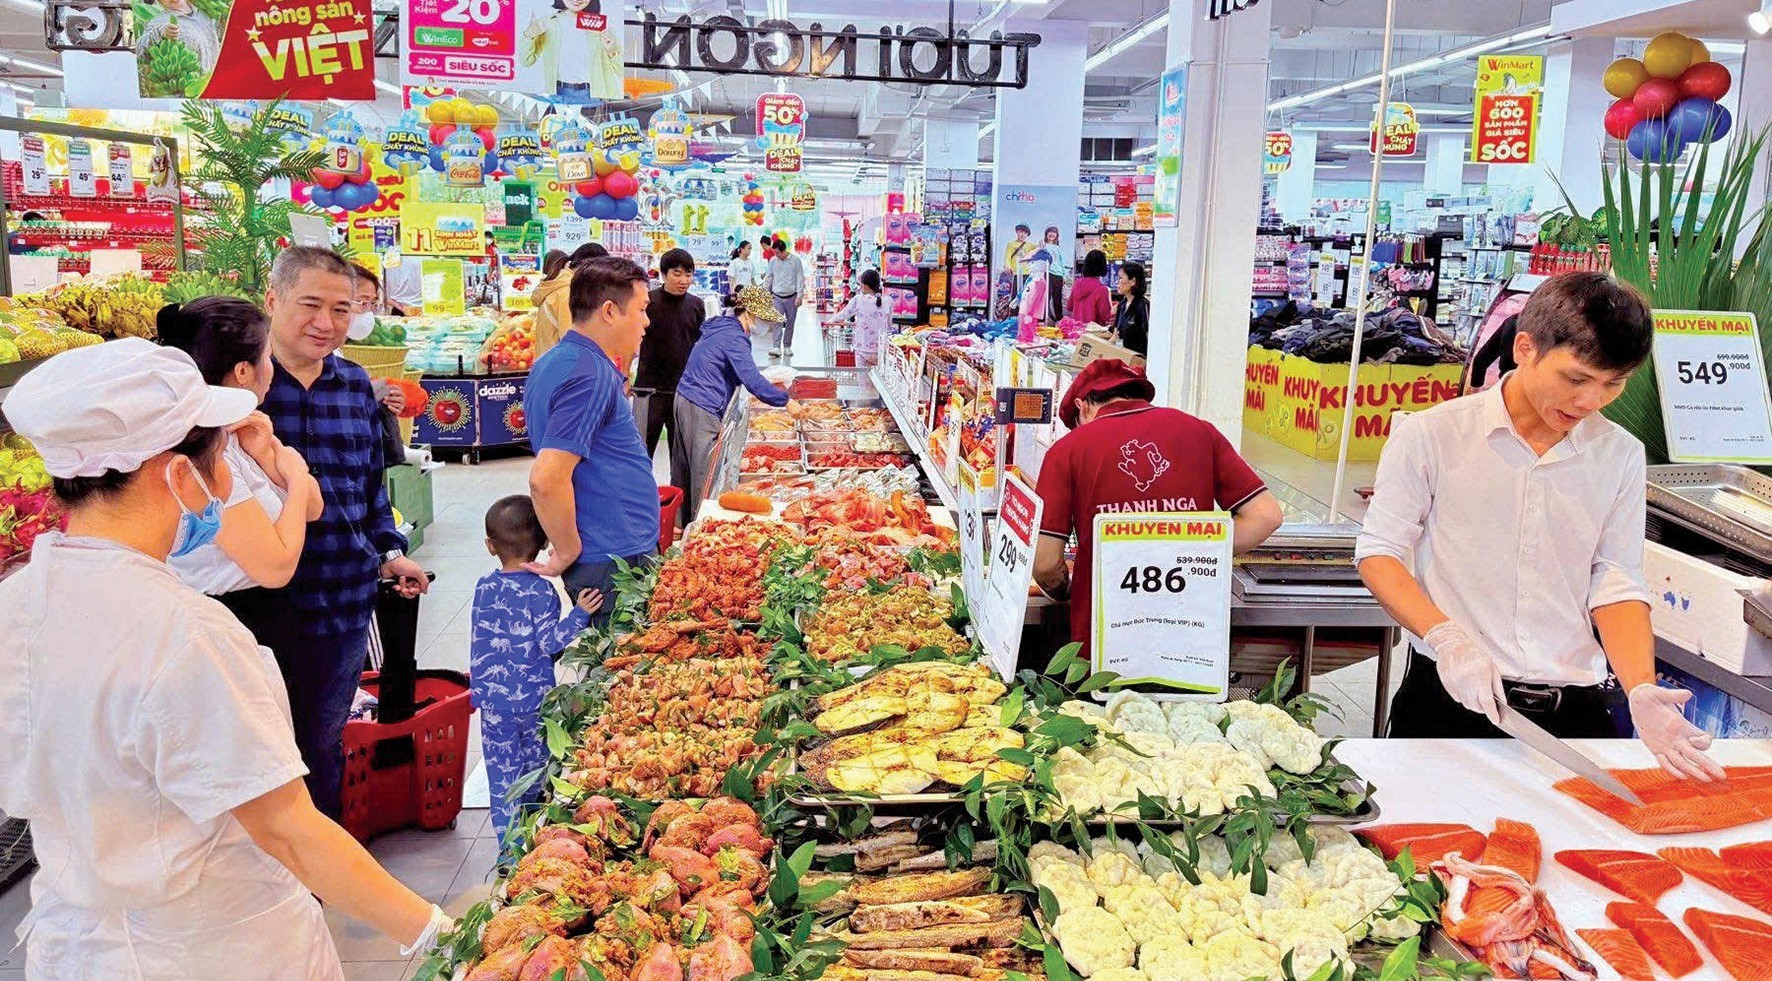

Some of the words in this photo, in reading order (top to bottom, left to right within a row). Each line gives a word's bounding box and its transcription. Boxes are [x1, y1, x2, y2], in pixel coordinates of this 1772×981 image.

[255, 5, 311, 27] nông
[316, 0, 354, 20] sản
[252, 22, 369, 85] VIỆT
[449, 60, 478, 71] SIÊU
[480, 61, 507, 73] SỐC
[1487, 58, 1535, 71] WinMart
[270, 109, 308, 127] DEAL
[764, 105, 800, 125] 50%
[1488, 107, 1525, 120] 600
[602, 124, 638, 139] DEAL
[1384, 123, 1414, 135] EAL
[388, 131, 425, 146] DEAL
[501, 136, 537, 148] DEAL
[657, 148, 685, 159] Downy
[770, 148, 797, 159] DEAL
[1480, 137, 1527, 161] SỐC
[408, 227, 432, 251] 11
[1677, 361, 1728, 385] 549
[478, 384, 517, 397] dazzle
[1246, 386, 1265, 411] MÃI
[1319, 373, 1452, 410] KHUYẾN
[1295, 403, 1318, 432] MÃI
[1097, 500, 1158, 514] THANH
[1162, 497, 1198, 512] NGA
[998, 533, 1017, 573] 299
[1120, 565, 1186, 594] 486
